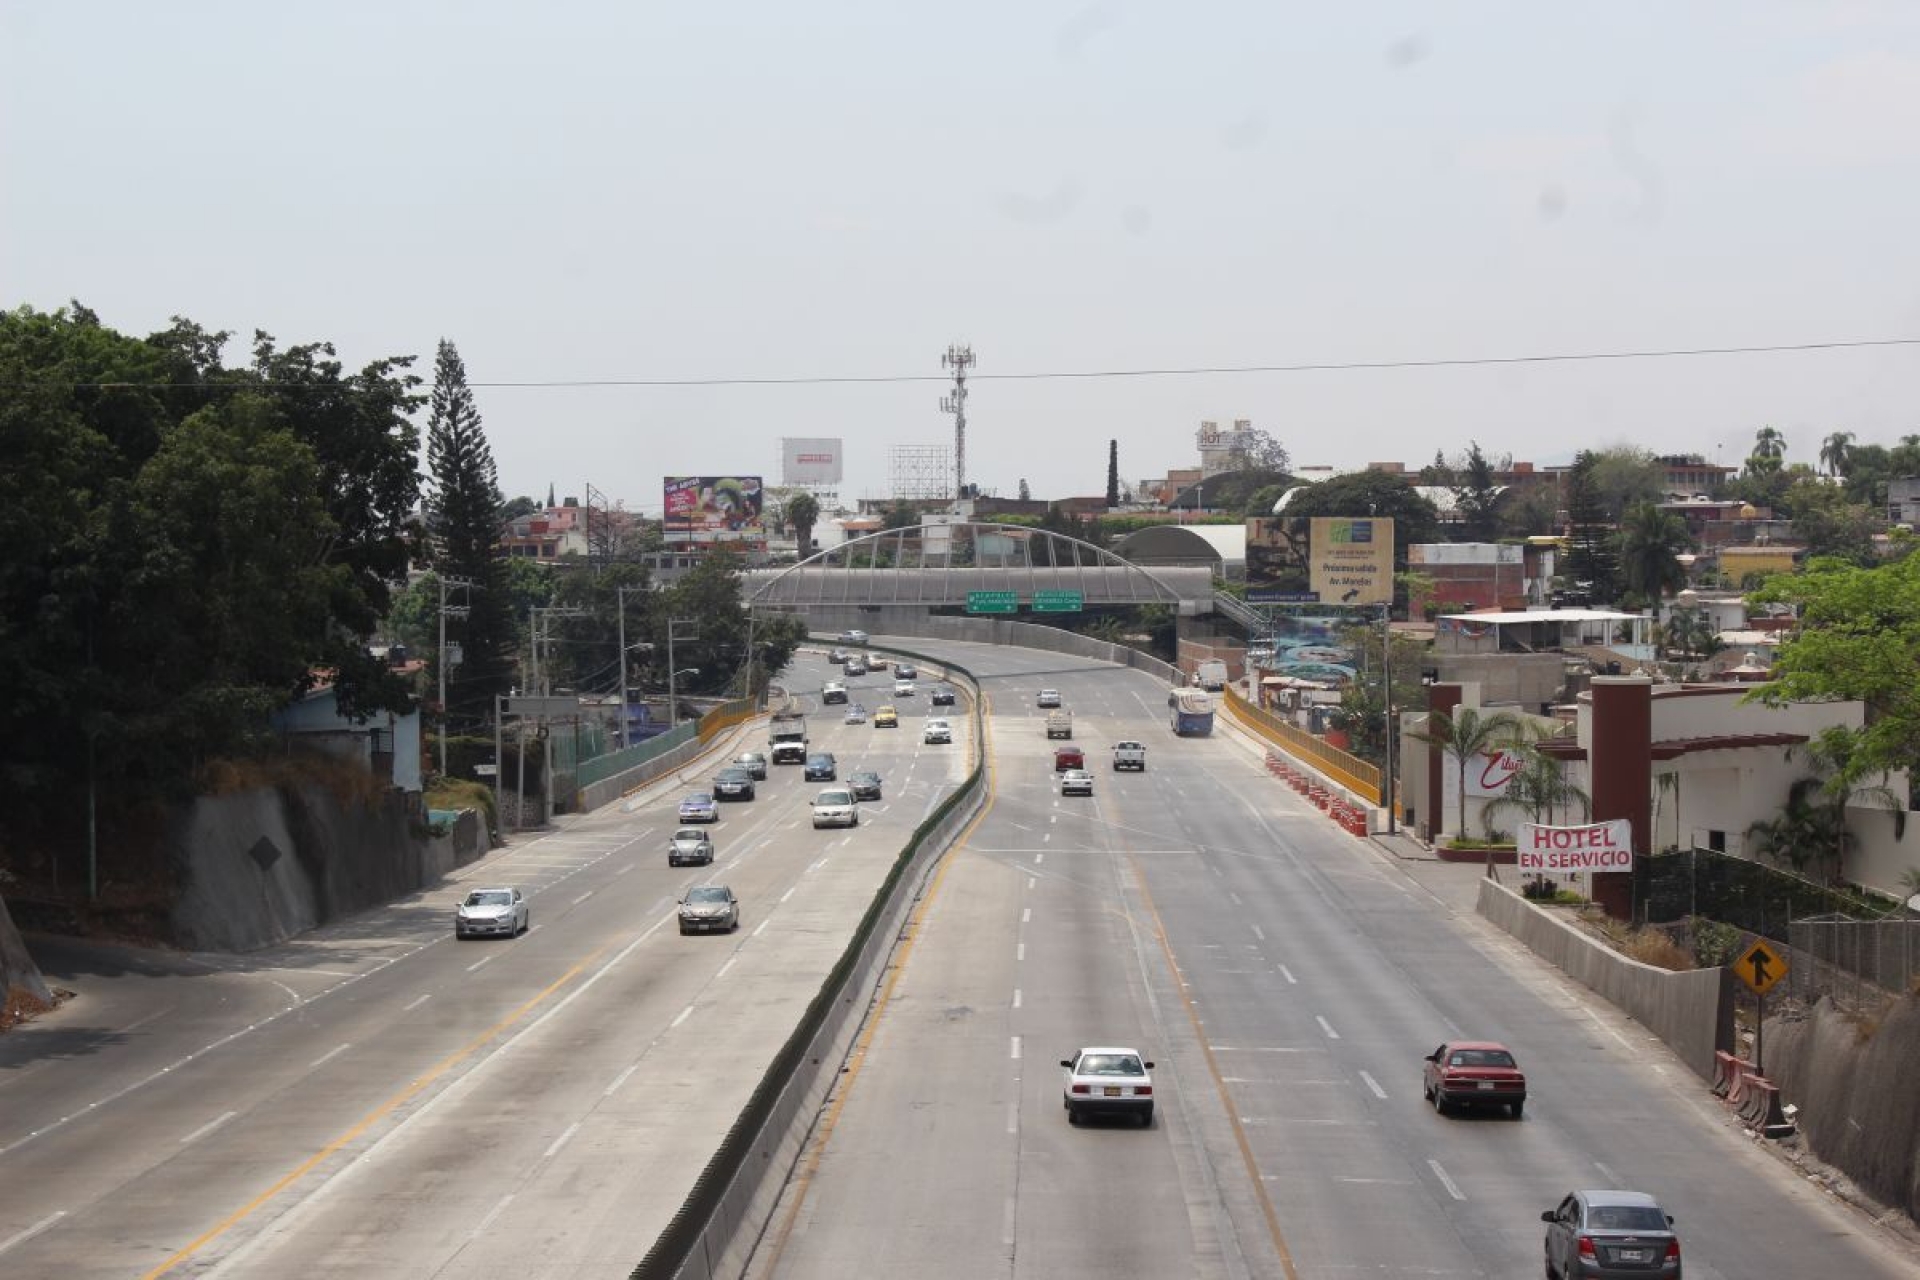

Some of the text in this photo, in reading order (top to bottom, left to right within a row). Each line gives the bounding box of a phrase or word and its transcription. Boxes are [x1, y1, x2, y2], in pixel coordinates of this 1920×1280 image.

[1533, 827, 1617, 849] HOTEL
[1520, 850, 1630, 868] EN SERVICIO
